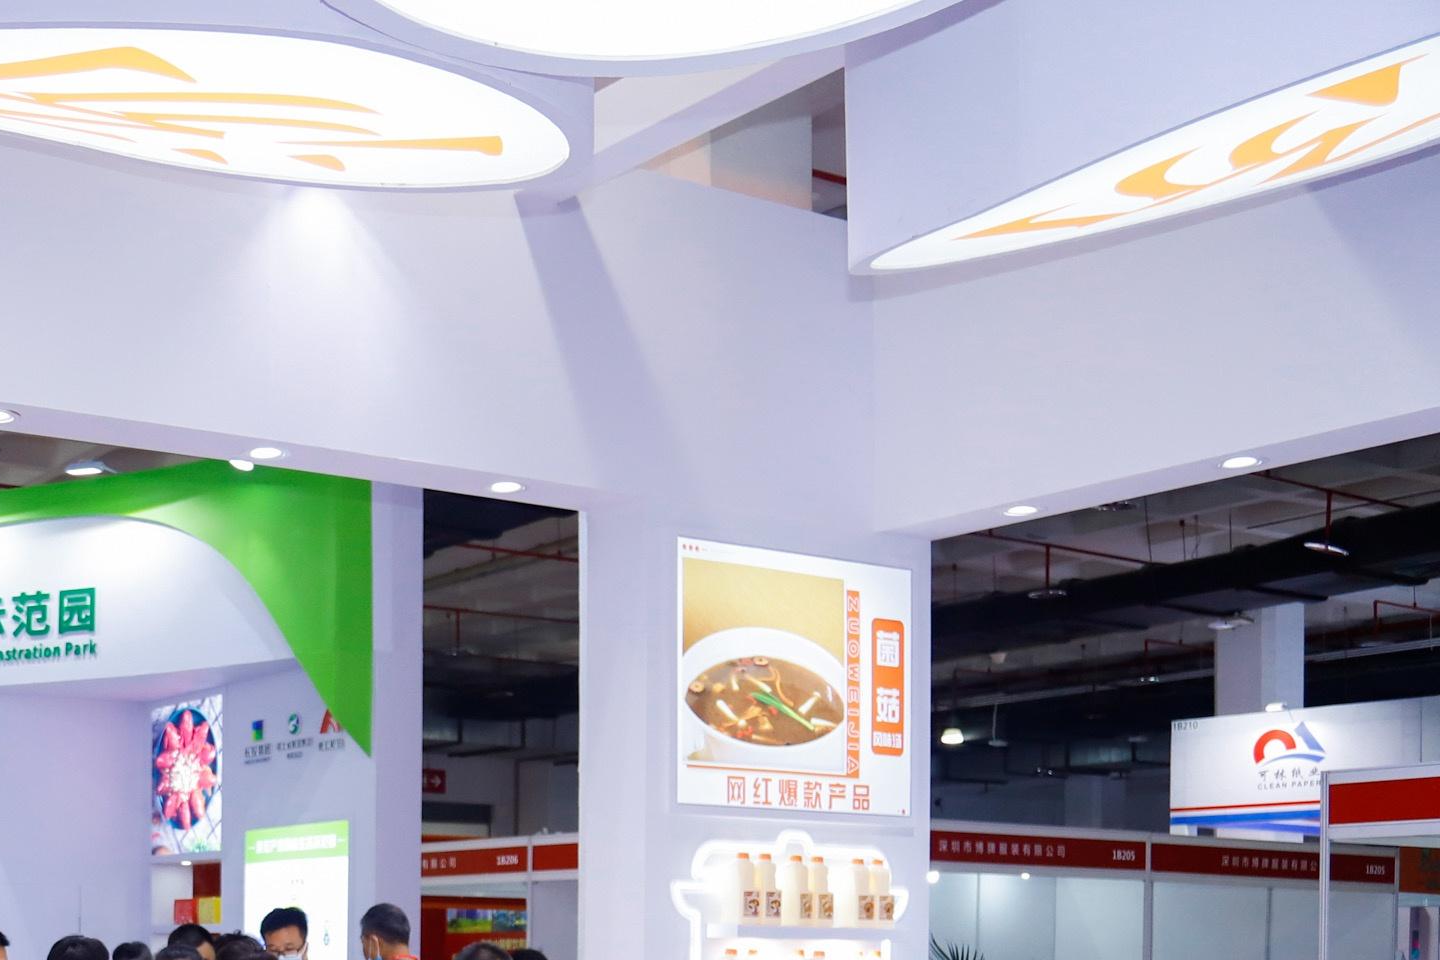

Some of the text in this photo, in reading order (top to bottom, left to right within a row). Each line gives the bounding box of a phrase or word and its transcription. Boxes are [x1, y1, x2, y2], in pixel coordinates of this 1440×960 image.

[65, 639, 97, 656] Park
[726, 775, 871, 812] 网红爆款产品
[1257, 781, 1288, 791] CLEAN
